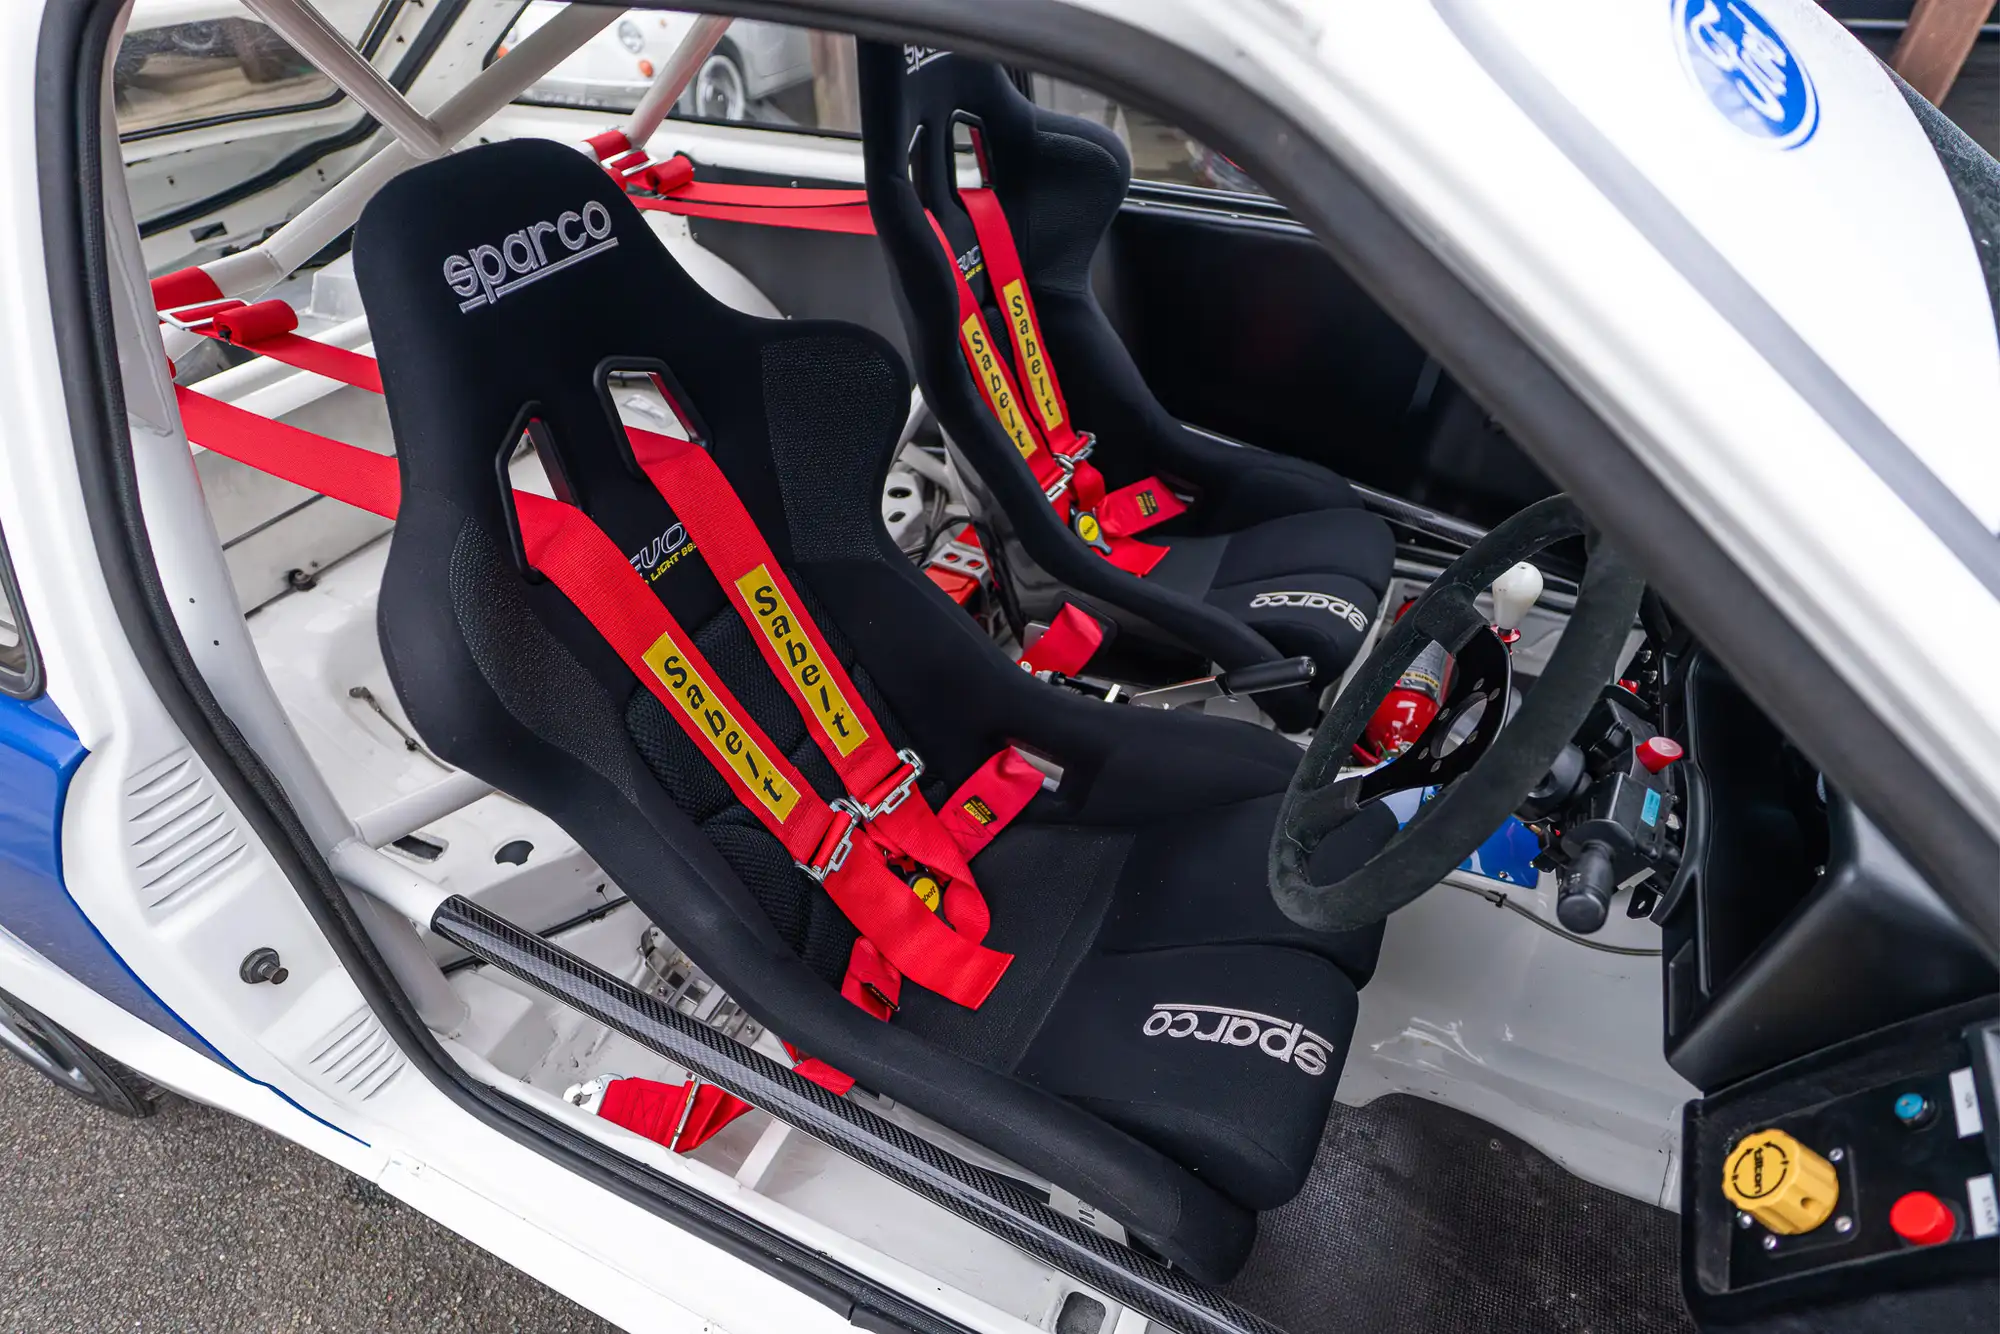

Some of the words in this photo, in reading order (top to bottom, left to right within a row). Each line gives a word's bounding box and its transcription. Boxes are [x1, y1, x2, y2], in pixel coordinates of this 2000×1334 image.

[443, 200, 619, 312] sparco
[972, 331, 1025, 448] Sabelt
[1012, 295, 1053, 416] Sabelt
[754, 585, 850, 738] Sabelt
[1249, 591, 1368, 632] sparco
[663, 655, 783, 803] Sabelt
[1143, 1004, 1334, 1076] sparco
